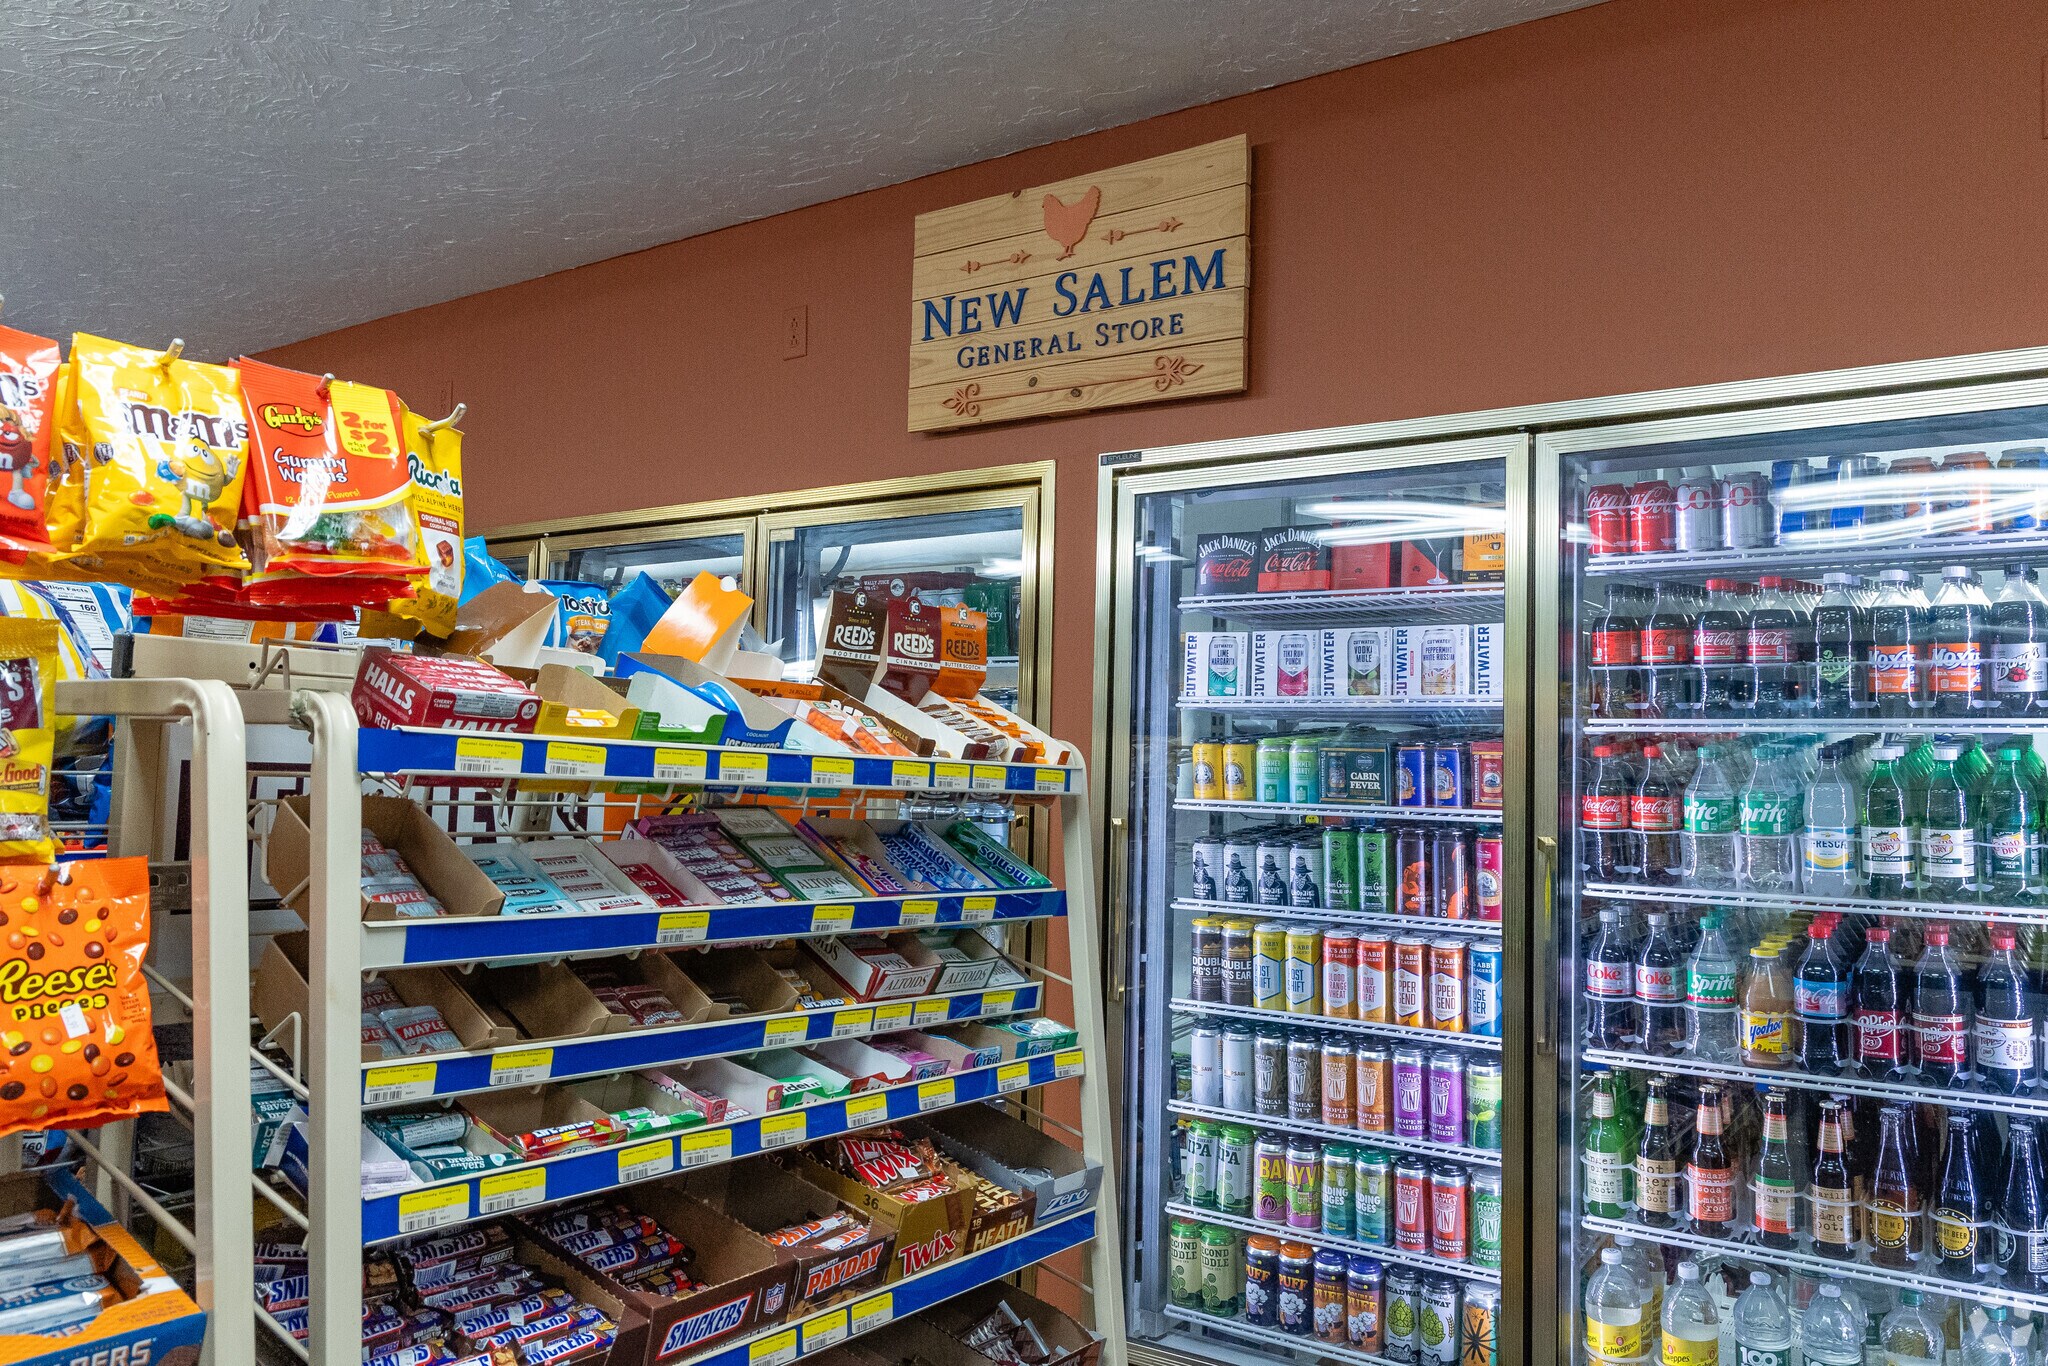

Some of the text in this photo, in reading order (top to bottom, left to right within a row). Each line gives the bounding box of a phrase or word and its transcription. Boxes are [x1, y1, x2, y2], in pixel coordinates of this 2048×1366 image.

[921, 248, 1227, 341] NEW SALEM
[957, 313, 1184, 369] GENERAL STORE
[264, 405, 322, 431] Gurley's
[340, 411, 386, 430] 2 for
[1199, 535, 1258, 559] JACK DANIEL'S
[1264, 532, 1287, 552] JACK
[1201, 558, 1254, 577] Coca-Cola
[1265, 551, 1322, 573] Coca-Cola
[79, 603, 97, 614] 160
[833, 624, 876, 647] REED'S
[894, 632, 934, 656] REED'S
[1697, 632, 1735, 646] Coca-Cola
[833, 650, 872, 660] ROOT BEER
[946, 638, 980, 656] REED'S
[1217, 650, 1229, 658] LIME
[896, 658, 933, 668] CINNAMON
[1356, 654, 1372, 663] MULE
[364, 661, 416, 712] HALLS
[798, 689, 812, 698] ROLLS
[1350, 772, 1380, 781] CABIN
[1350, 781, 1381, 790] FEVER
[1585, 799, 1620, 813] Coca-Cola
[1635, 799, 1673, 814] Coca-Cola
[907, 828, 952, 873] mentos
[1879, 844, 1896, 853] DRY
[2002, 845, 2020, 855] DRY
[978, 844, 1030, 885] mentos
[798, 876, 848, 891] ALTOIDS
[379, 891, 424, 903] MAPLE
[0, 957, 117, 1002] Reese's
[945, 969, 988, 985] ALTOIDS
[1235, 971, 1252, 980] EAR
[1587, 964, 1622, 981] Coke
[1638, 967, 1672, 985] Coke
[884, 974, 929, 991] ALTOIDS
[1691, 974, 1736, 992] Sprite
[402, 1021, 447, 1039] MAPLE
[1188, 1140, 1212, 1157] IPA
[862, 1194, 896, 1219] 36 COUNT
[973, 1216, 1028, 1253] HEATH
[1951, 1230, 1968, 1240] BEER
[804, 1242, 885, 1299] PAYDAY
[1279, 1273, 1309, 1291] PUFF
[665, 1298, 748, 1352] SNICKERS
[1603, 1339, 1638, 1356] Schweppes
